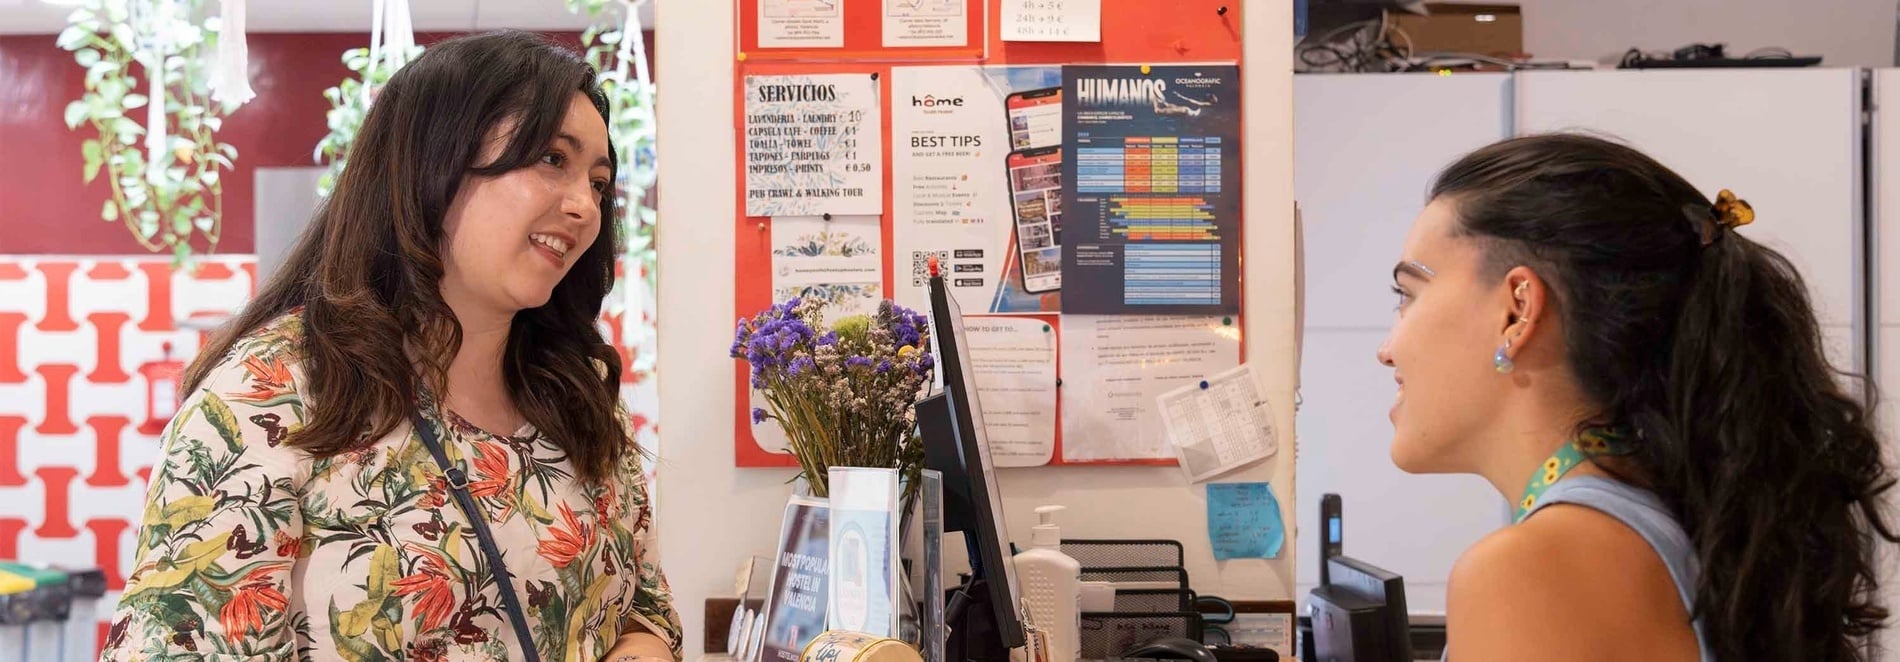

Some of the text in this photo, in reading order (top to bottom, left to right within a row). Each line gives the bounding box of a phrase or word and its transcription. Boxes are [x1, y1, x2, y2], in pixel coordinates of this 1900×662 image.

[758, 84, 836, 103] SERVICIOS
[1077, 78, 1166, 104] HUMANOS
[803, 113, 837, 123] LAUNDRY
[750, 139, 778, 149] TOALLA
[786, 139, 812, 148] TOWEL
[911, 135, 981, 148] BEST TIPS
[749, 189, 766, 199] PUB
[805, 188, 840, 198] WALKING
[842, 187, 863, 197] TOUR
[781, 551, 802, 569] MOST
[786, 572, 821, 593] HOSTEL IN
[783, 589, 817, 612] VALENCIA
